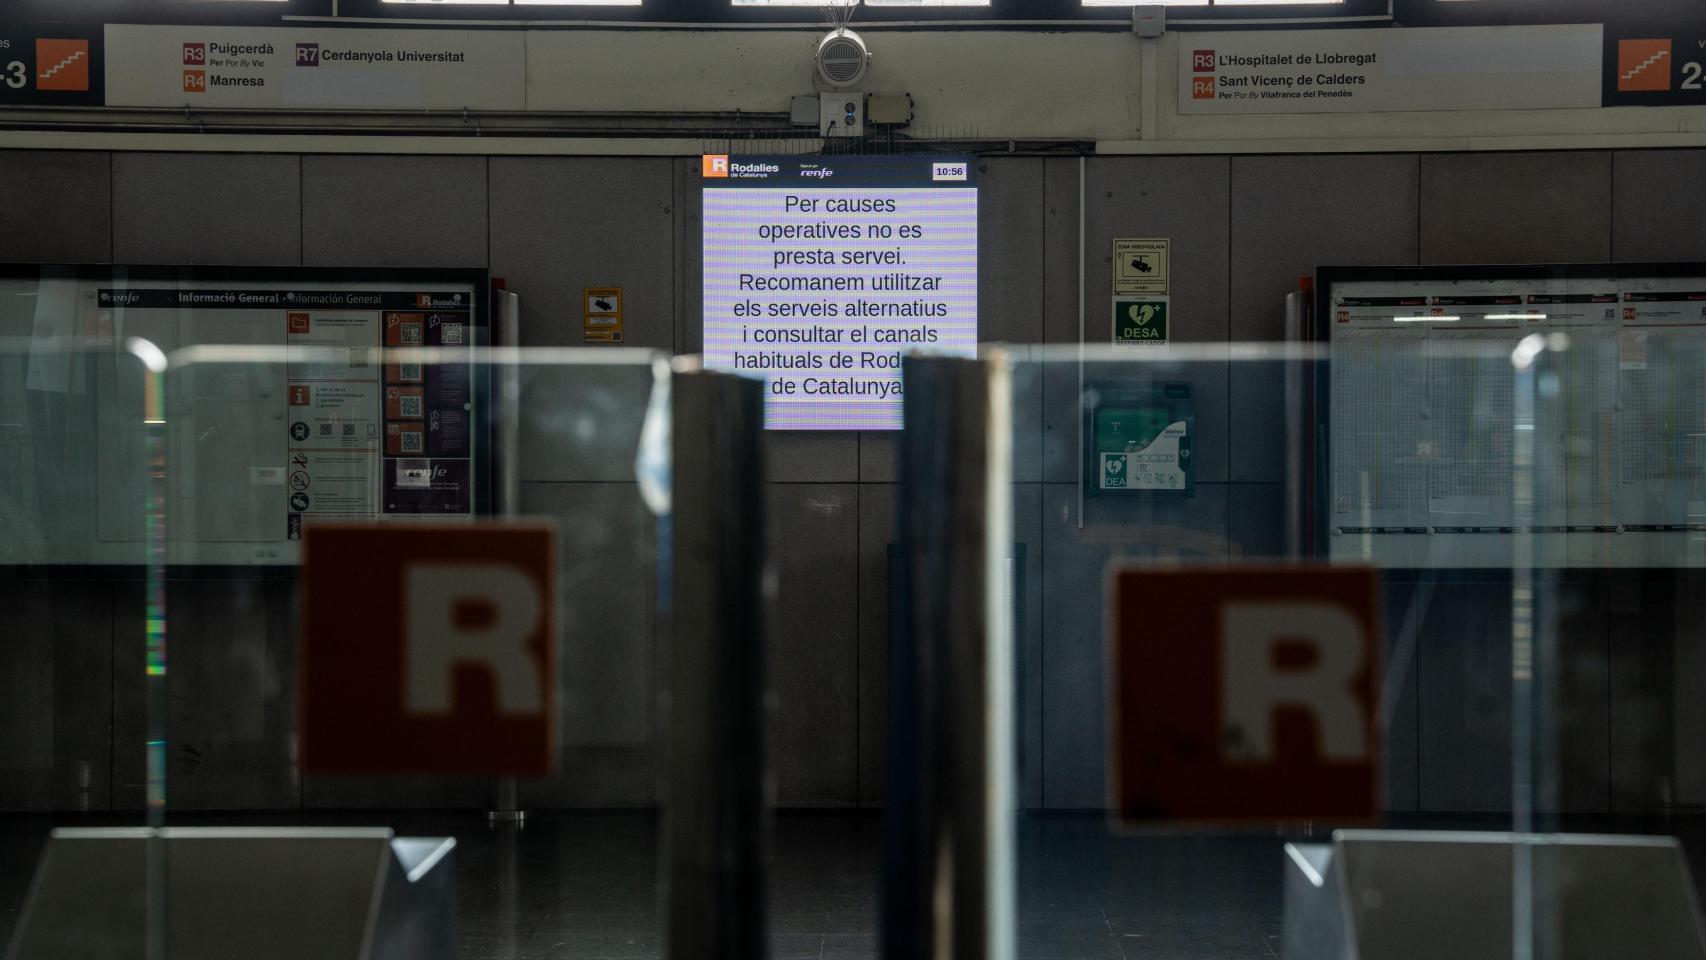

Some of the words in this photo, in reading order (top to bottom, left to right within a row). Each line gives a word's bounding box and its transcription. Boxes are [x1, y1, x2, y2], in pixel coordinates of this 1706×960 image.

[184, 47, 204, 60] R3
[210, 43, 274, 56] Puigcerdà
[296, 48, 318, 62] R7
[322, 50, 393, 63] Cerdanyola
[397, 51, 464, 62] Universitat
[1194, 54, 1214, 67] R3
[1219, 54, 1292, 68] L'Hospitalet
[1296, 54, 1312, 65] de
[1316, 53, 1376, 66] Llobregat
[184, 75, 204, 88] R4
[210, 75, 264, 86] Manresa
[1194, 81, 1214, 94] R4
[1219, 76, 1248, 87] Sant
[1251, 75, 1294, 88] Vicenç
[1297, 74, 1313, 86] de
[1316, 74, 1365, 85] Calders
[1249, 92, 1259, 100] By
[1260, 91, 1300, 99] Vilafranca
[713, 158, 727, 172] R
[731, 163, 779, 172] Rodalies
[801, 168, 833, 179] renfe
[937, 167, 962, 176] 10:56
[785, 195, 820, 213] Per
[825, 198, 896, 213] causes
[759, 221, 861, 243] operatives
[868, 224, 892, 239] no
[899, 224, 922, 239] es
[774, 248, 835, 269] presta
[841, 247, 906, 265] servei.
[740, 274, 864, 291] Recomanem
[872, 273, 942, 291] utilitzar
[178, 292, 236, 303] Informació
[239, 293, 280, 303] General
[346, 294, 382, 304] General
[733, 299, 761, 317] els
[768, 299, 838, 317] serveis
[845, 299, 947, 317] alternatius
[743, 325, 747, 342] i
[754, 325, 844, 343] consultar
[851, 325, 867, 343] el
[874, 325, 938, 343] canals
[1124, 327, 1159, 338] DESA
[734, 351, 823, 369] habituals
[829, 351, 853, 369] de
[861, 351, 901, 369] Rod
[772, 377, 796, 395] de
[803, 377, 904, 399] Catalunya
[1105, 477, 1126, 486] DEA
[405, 563, 542, 714] R
[1221, 601, 1368, 763] R
